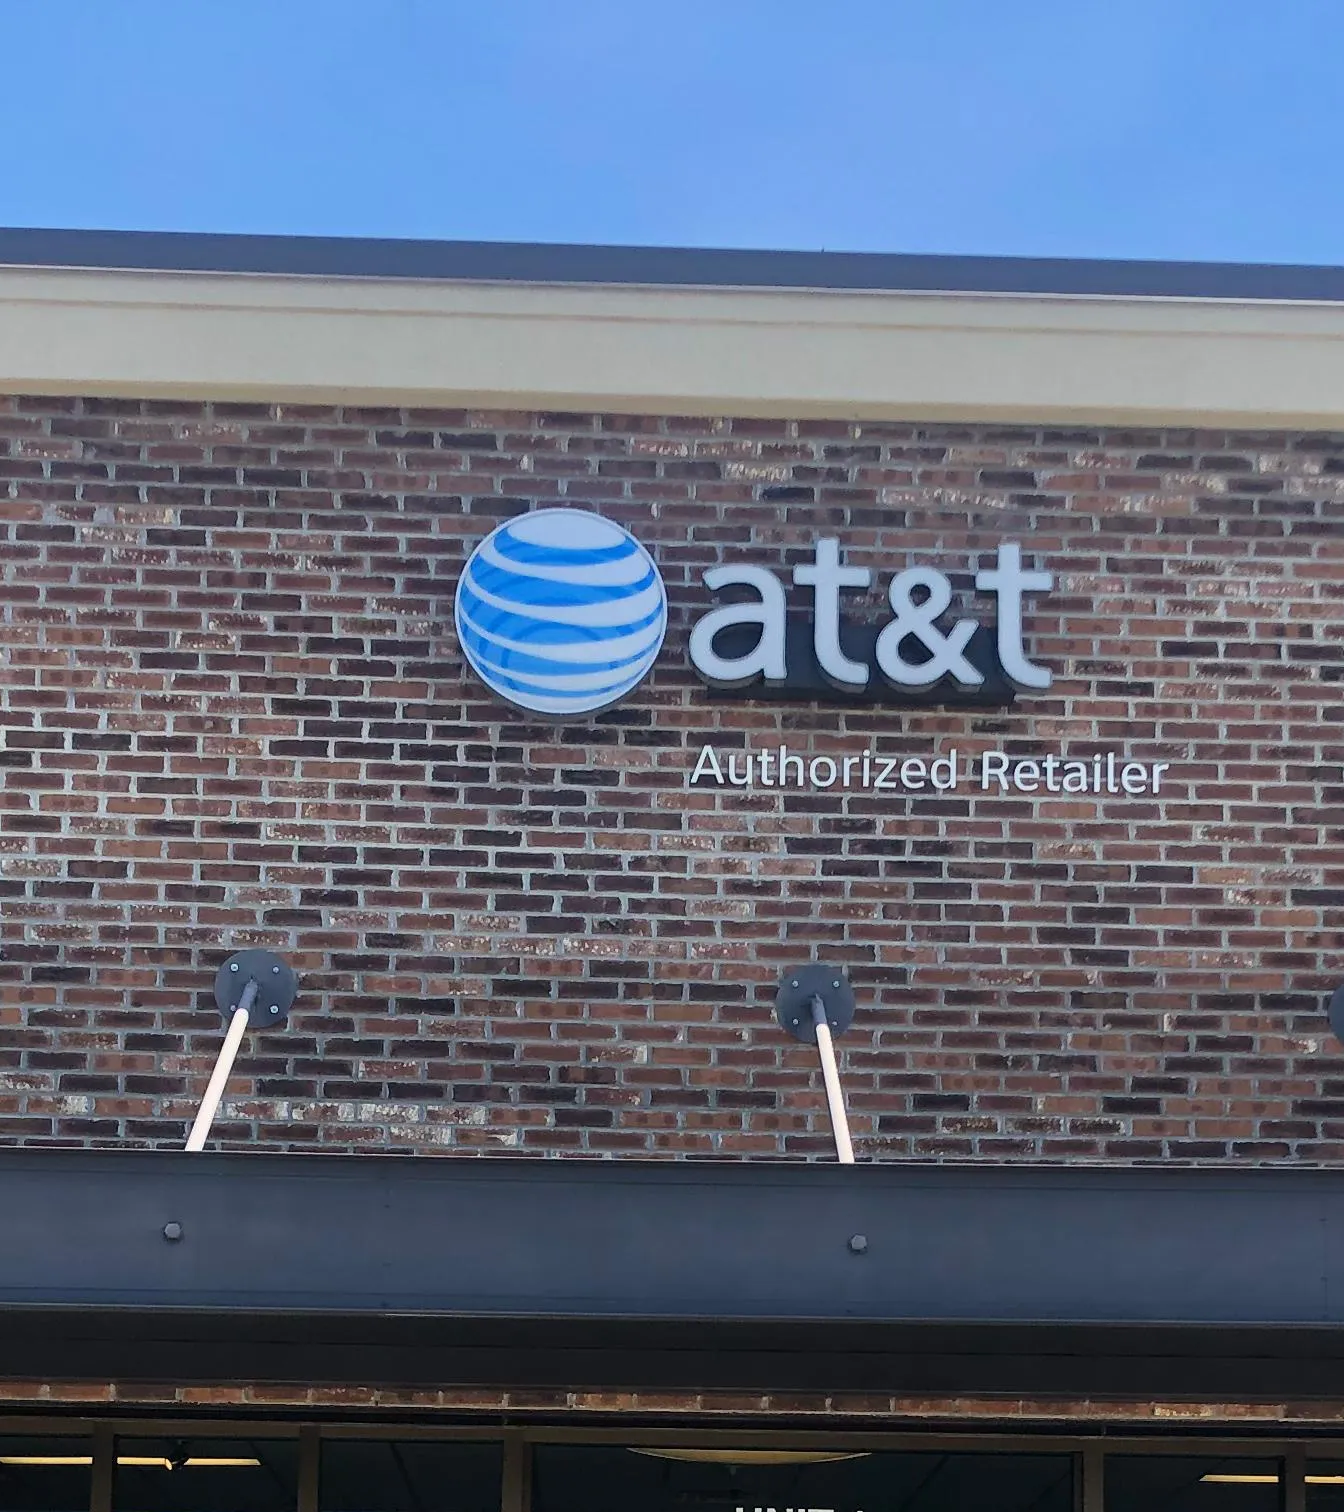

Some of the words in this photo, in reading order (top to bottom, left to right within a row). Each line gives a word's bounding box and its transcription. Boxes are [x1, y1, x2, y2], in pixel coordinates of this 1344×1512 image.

[688, 538, 1053, 690] at&t
[689, 745, 958, 790] Authorized
[981, 751, 1170, 795] Retailer
